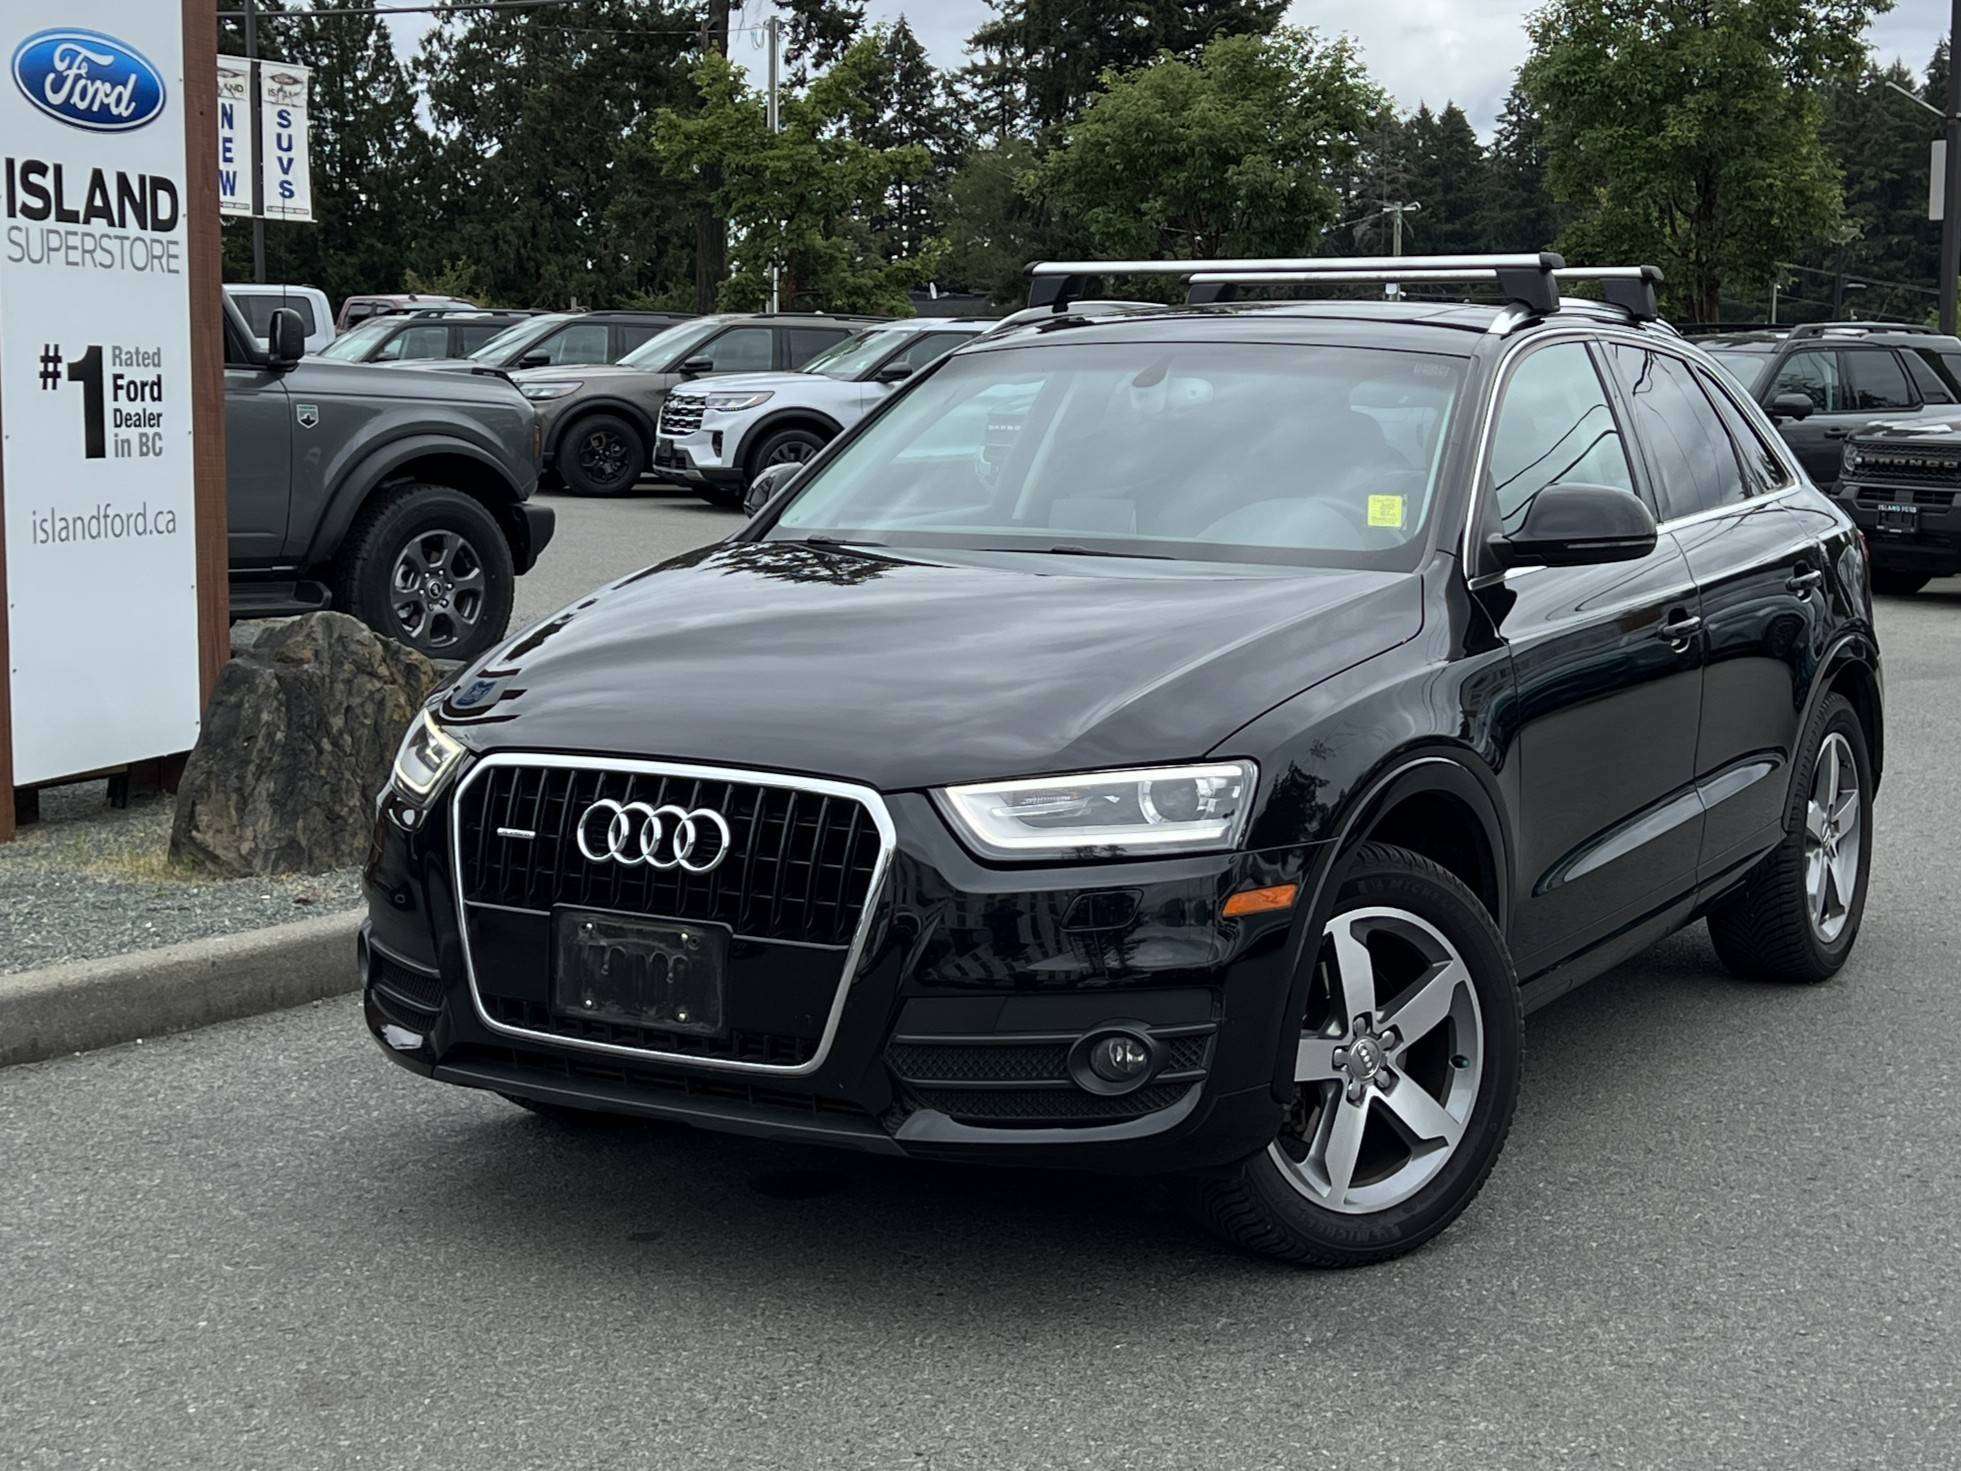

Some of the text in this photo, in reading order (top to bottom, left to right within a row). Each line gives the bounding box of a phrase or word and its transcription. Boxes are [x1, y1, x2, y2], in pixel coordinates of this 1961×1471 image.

[44, 43, 137, 118] Ford
[5, 157, 179, 233] ISLAND
[6, 225, 180, 274] SUPERSTORE
[112, 345, 162, 368] Rated
[39, 343, 106, 459] #1
[112, 373, 163, 402] Ford
[113, 408, 163, 428] Dealer
[114, 432, 163, 458] in BC
[32, 502, 176, 544] islandford.ca
